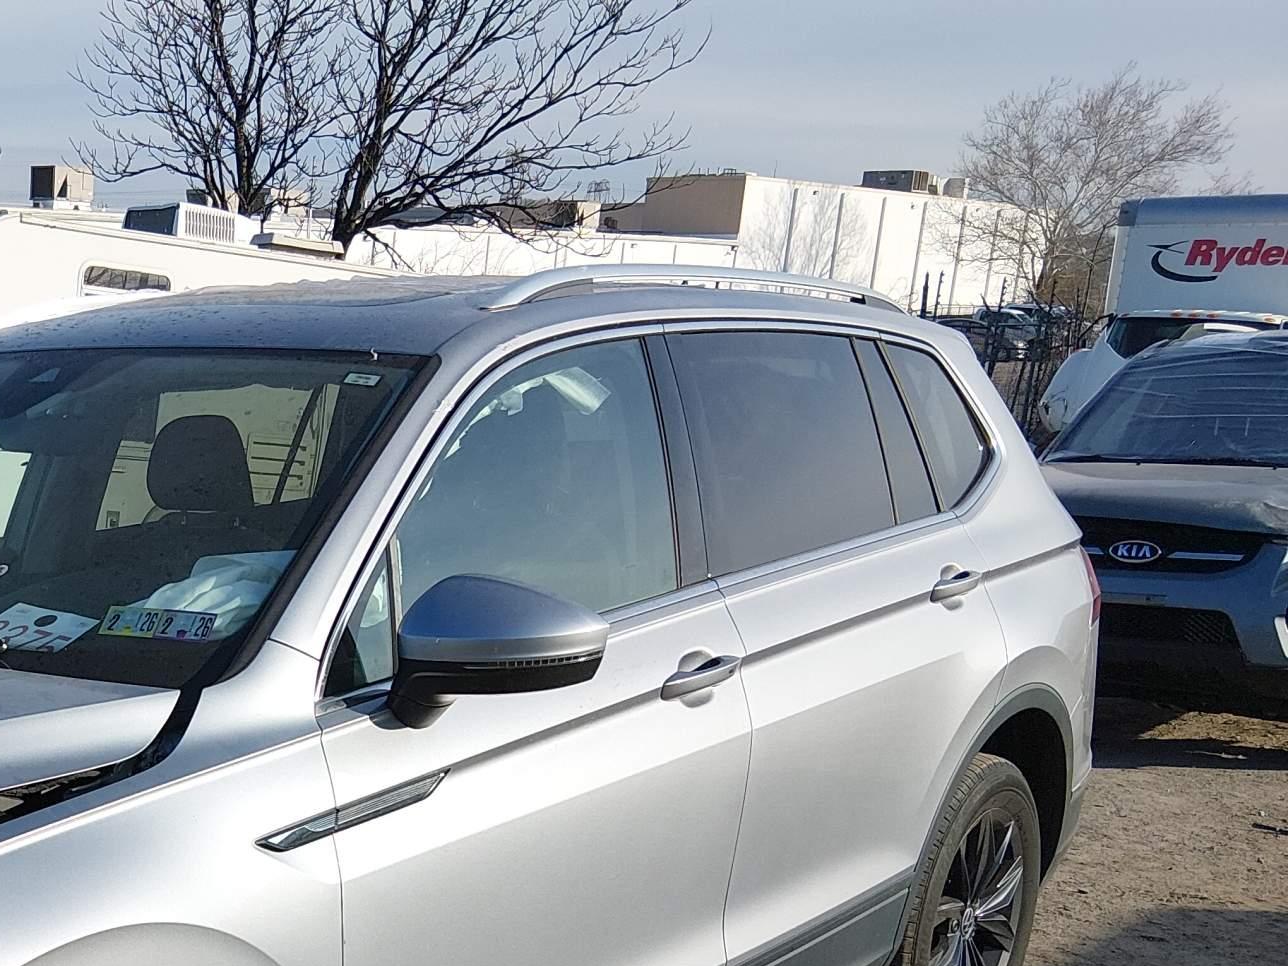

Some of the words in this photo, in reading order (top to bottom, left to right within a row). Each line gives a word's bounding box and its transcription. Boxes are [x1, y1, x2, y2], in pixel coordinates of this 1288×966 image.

[1117, 544, 1151, 558] KIA
[107, 614, 121, 632] 2
[139, 612, 160, 633] 26
[160, 617, 174, 635] 2
[193, 617, 213, 638] 26
